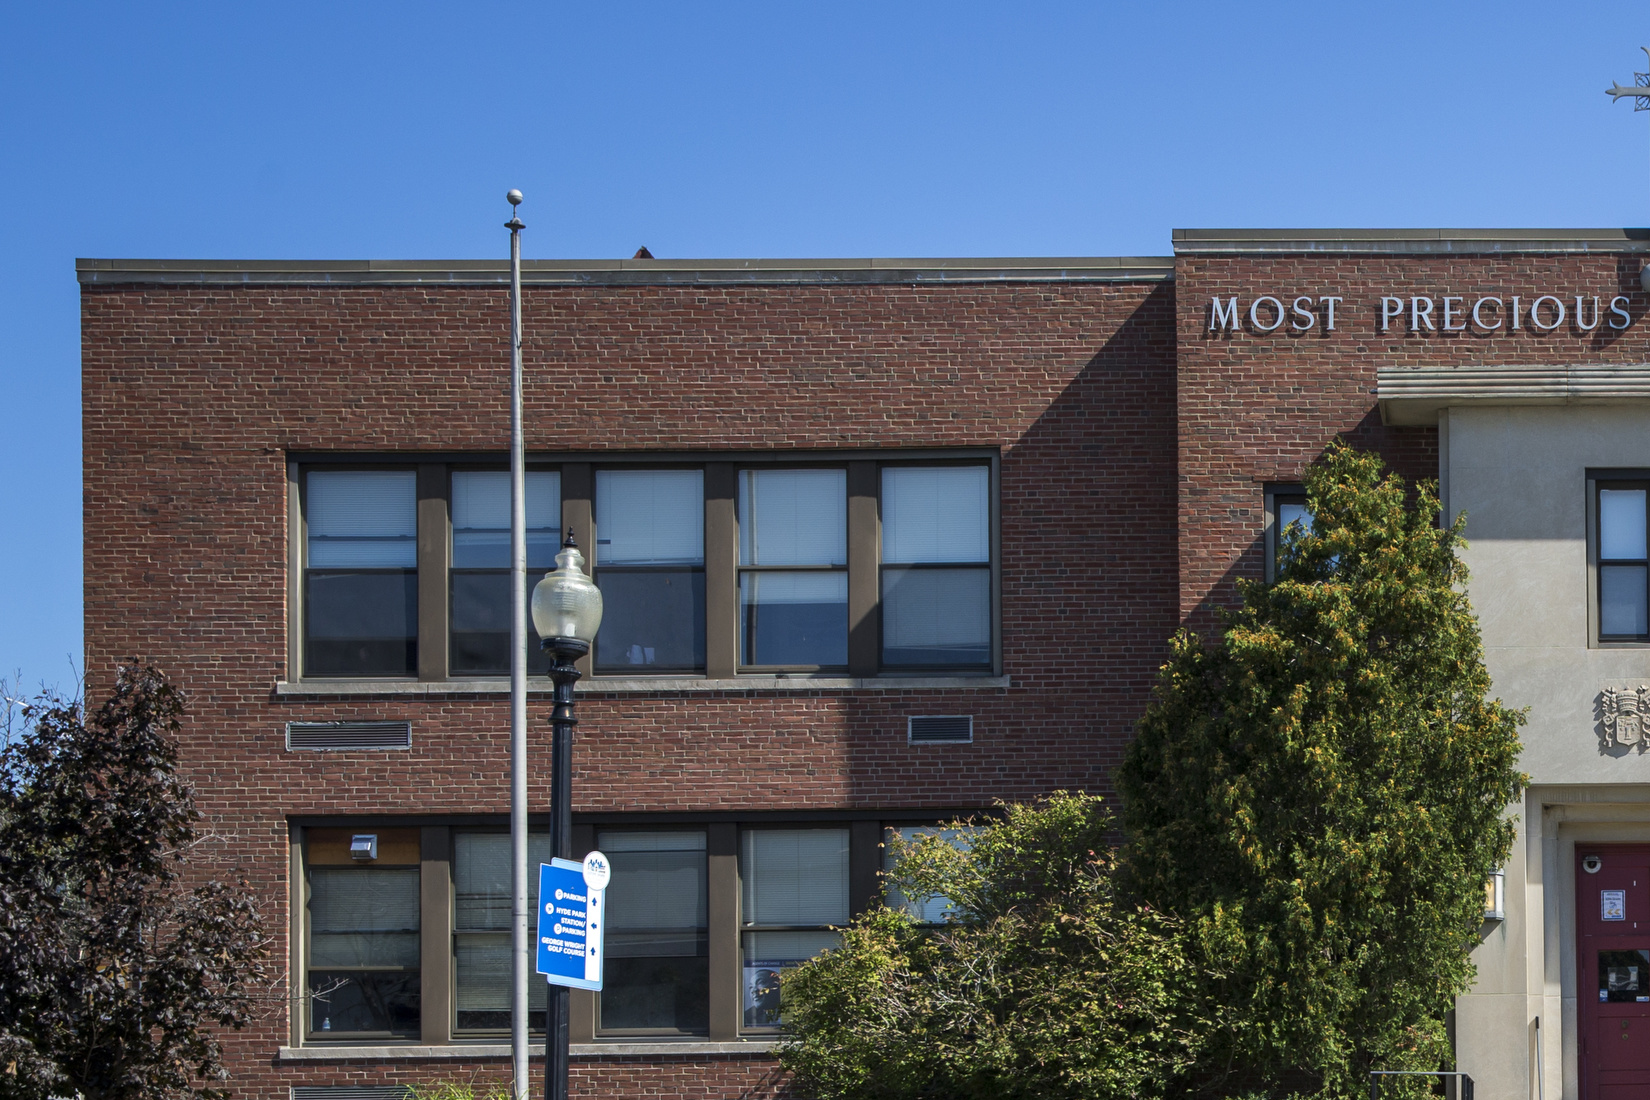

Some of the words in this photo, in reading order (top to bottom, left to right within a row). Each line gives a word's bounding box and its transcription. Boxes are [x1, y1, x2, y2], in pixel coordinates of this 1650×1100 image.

[1209, 296, 1343, 331] MOST
[1380, 295, 1631, 331] PRECIOUS
[563, 892, 586, 902] PARKING
[556, 907, 571, 916] HYDE
[572, 910, 586, 918] PARK
[562, 927, 585, 936] PARKING
[542, 937, 563, 946] GEORGE
[564, 941, 585, 950] WRIGHT
[563, 948, 585, 957] COURSE
